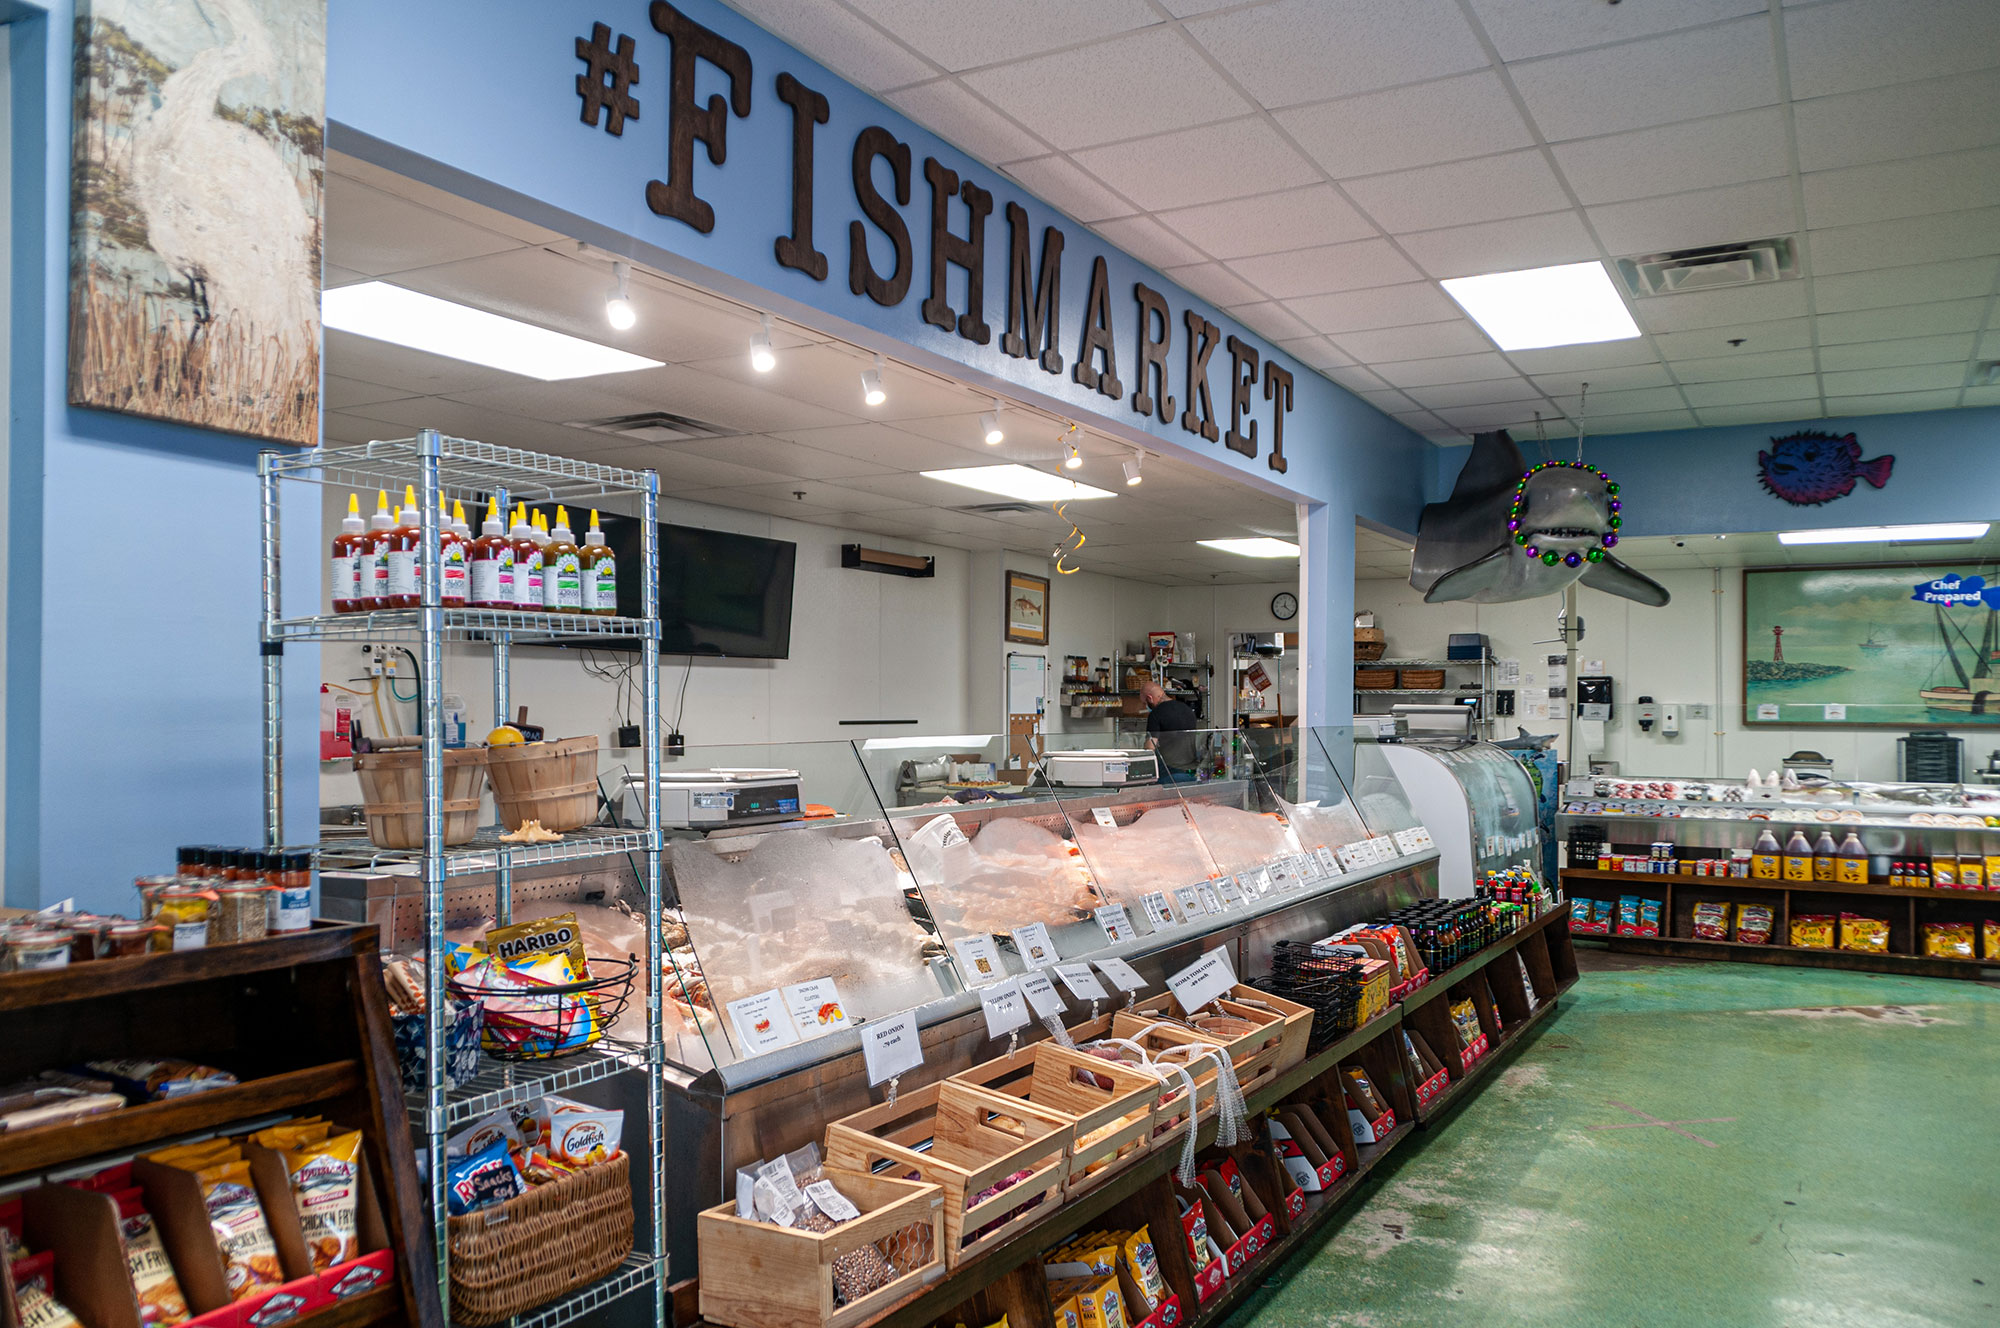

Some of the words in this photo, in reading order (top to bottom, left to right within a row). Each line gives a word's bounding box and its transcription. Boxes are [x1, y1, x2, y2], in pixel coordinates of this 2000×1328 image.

[575, 0, 1296, 475] #FISHMARKET
[1931, 580, 1961, 590] Chef
[1924, 591, 1981, 602] Prepared
[498, 927, 572, 960] HARIBO
[1174, 976, 1190, 987] ROMA
[1190, 959, 1217, 978] TOMATOES
[1198, 973, 1209, 982] each
[876, 1031, 888, 1040] RED
[888, 1023, 905, 1035] ONION
[567, 1130, 604, 1152] Goldfish
[300, 1163, 350, 1183] LOUISIANA
[474, 1169, 512, 1191] Snacks
[300, 1211, 336, 1232] CHICKEN
